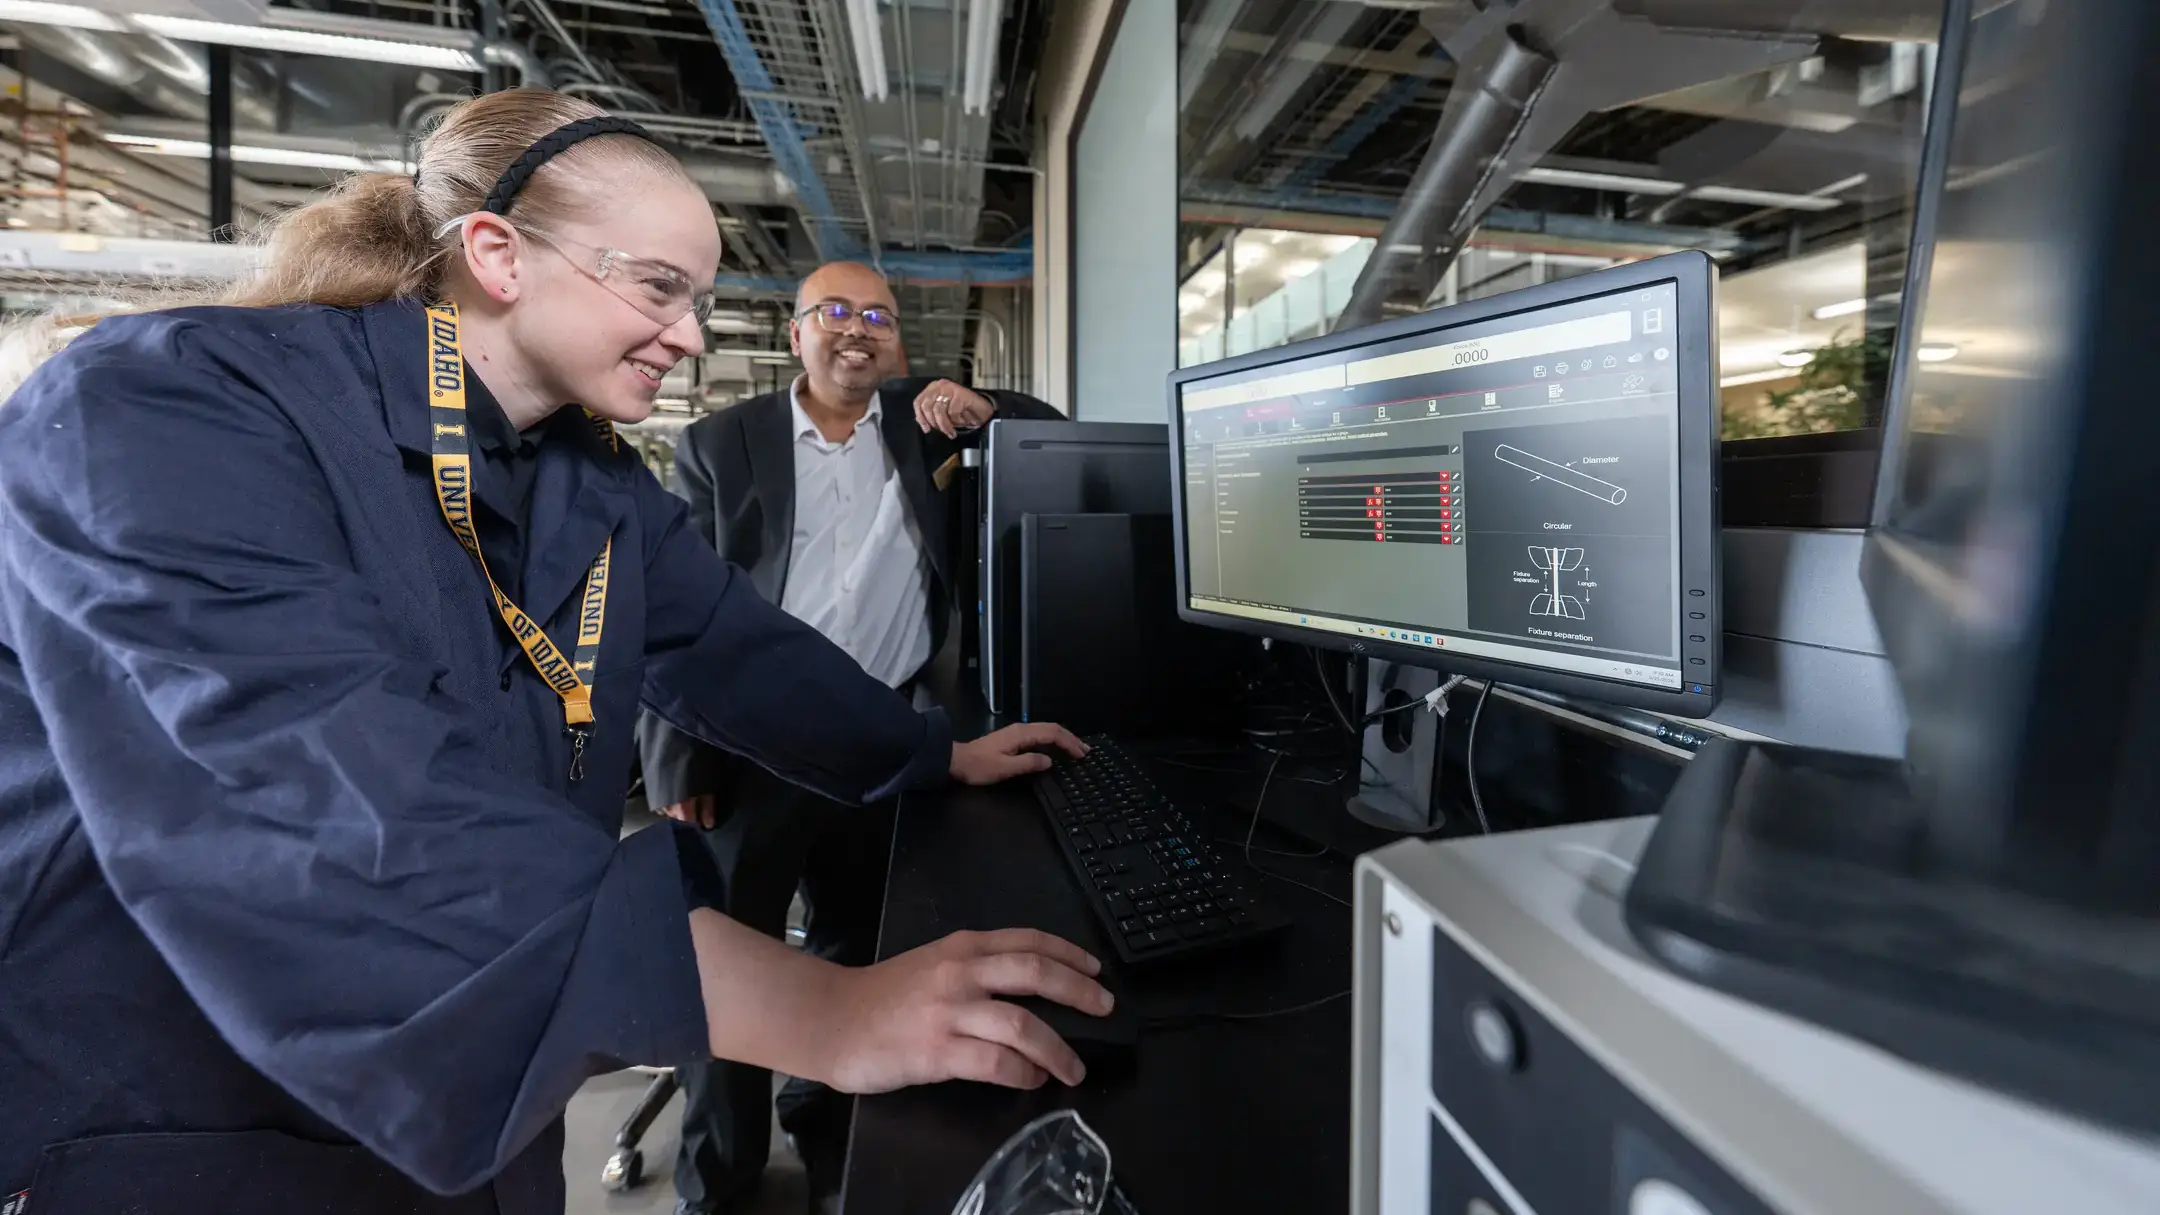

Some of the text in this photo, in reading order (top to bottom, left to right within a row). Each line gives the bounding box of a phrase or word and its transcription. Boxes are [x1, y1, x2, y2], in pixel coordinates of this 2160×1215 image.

[1451, 348, 1489, 365] .0000
[1582, 456, 1619, 464] Diameter
[438, 464, 480, 558] UNIVE
[1543, 522, 1572, 530] Circular
[1513, 576, 1540, 584] separation
[1577, 580, 1598, 588] Length
[511, 612, 538, 643] OF
[1528, 626, 1593, 642] Fixture separation
